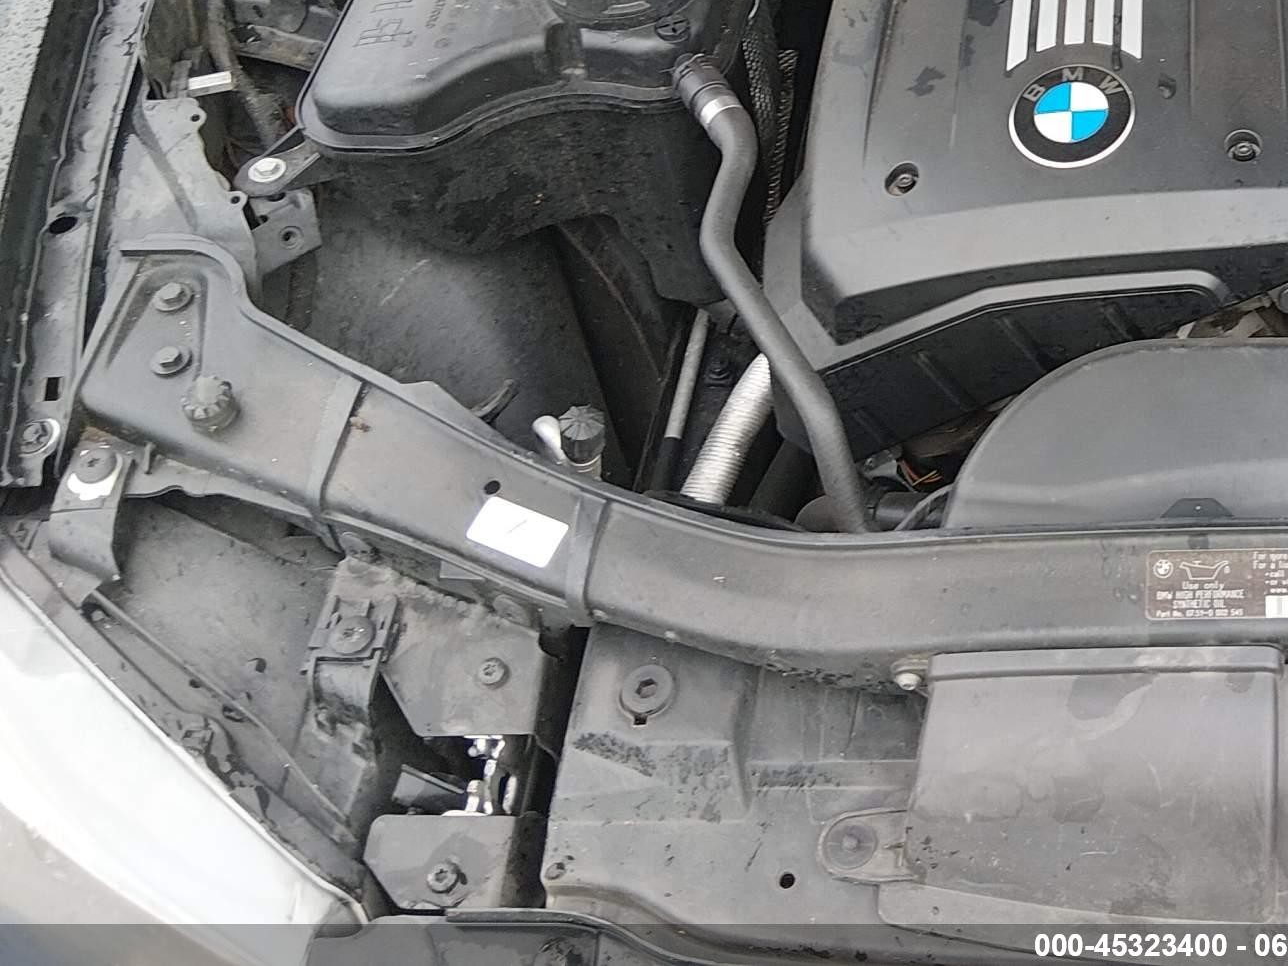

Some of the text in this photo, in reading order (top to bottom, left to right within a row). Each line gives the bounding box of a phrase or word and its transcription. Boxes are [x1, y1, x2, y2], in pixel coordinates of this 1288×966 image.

[1022, 67, 1124, 102] BMW
[1182, 580, 1225, 591] Use only
[1156, 588, 1245, 601] BMW HIGH PERFORMANCE
[1173, 599, 1227, 609] SYNTHETIC OIL
